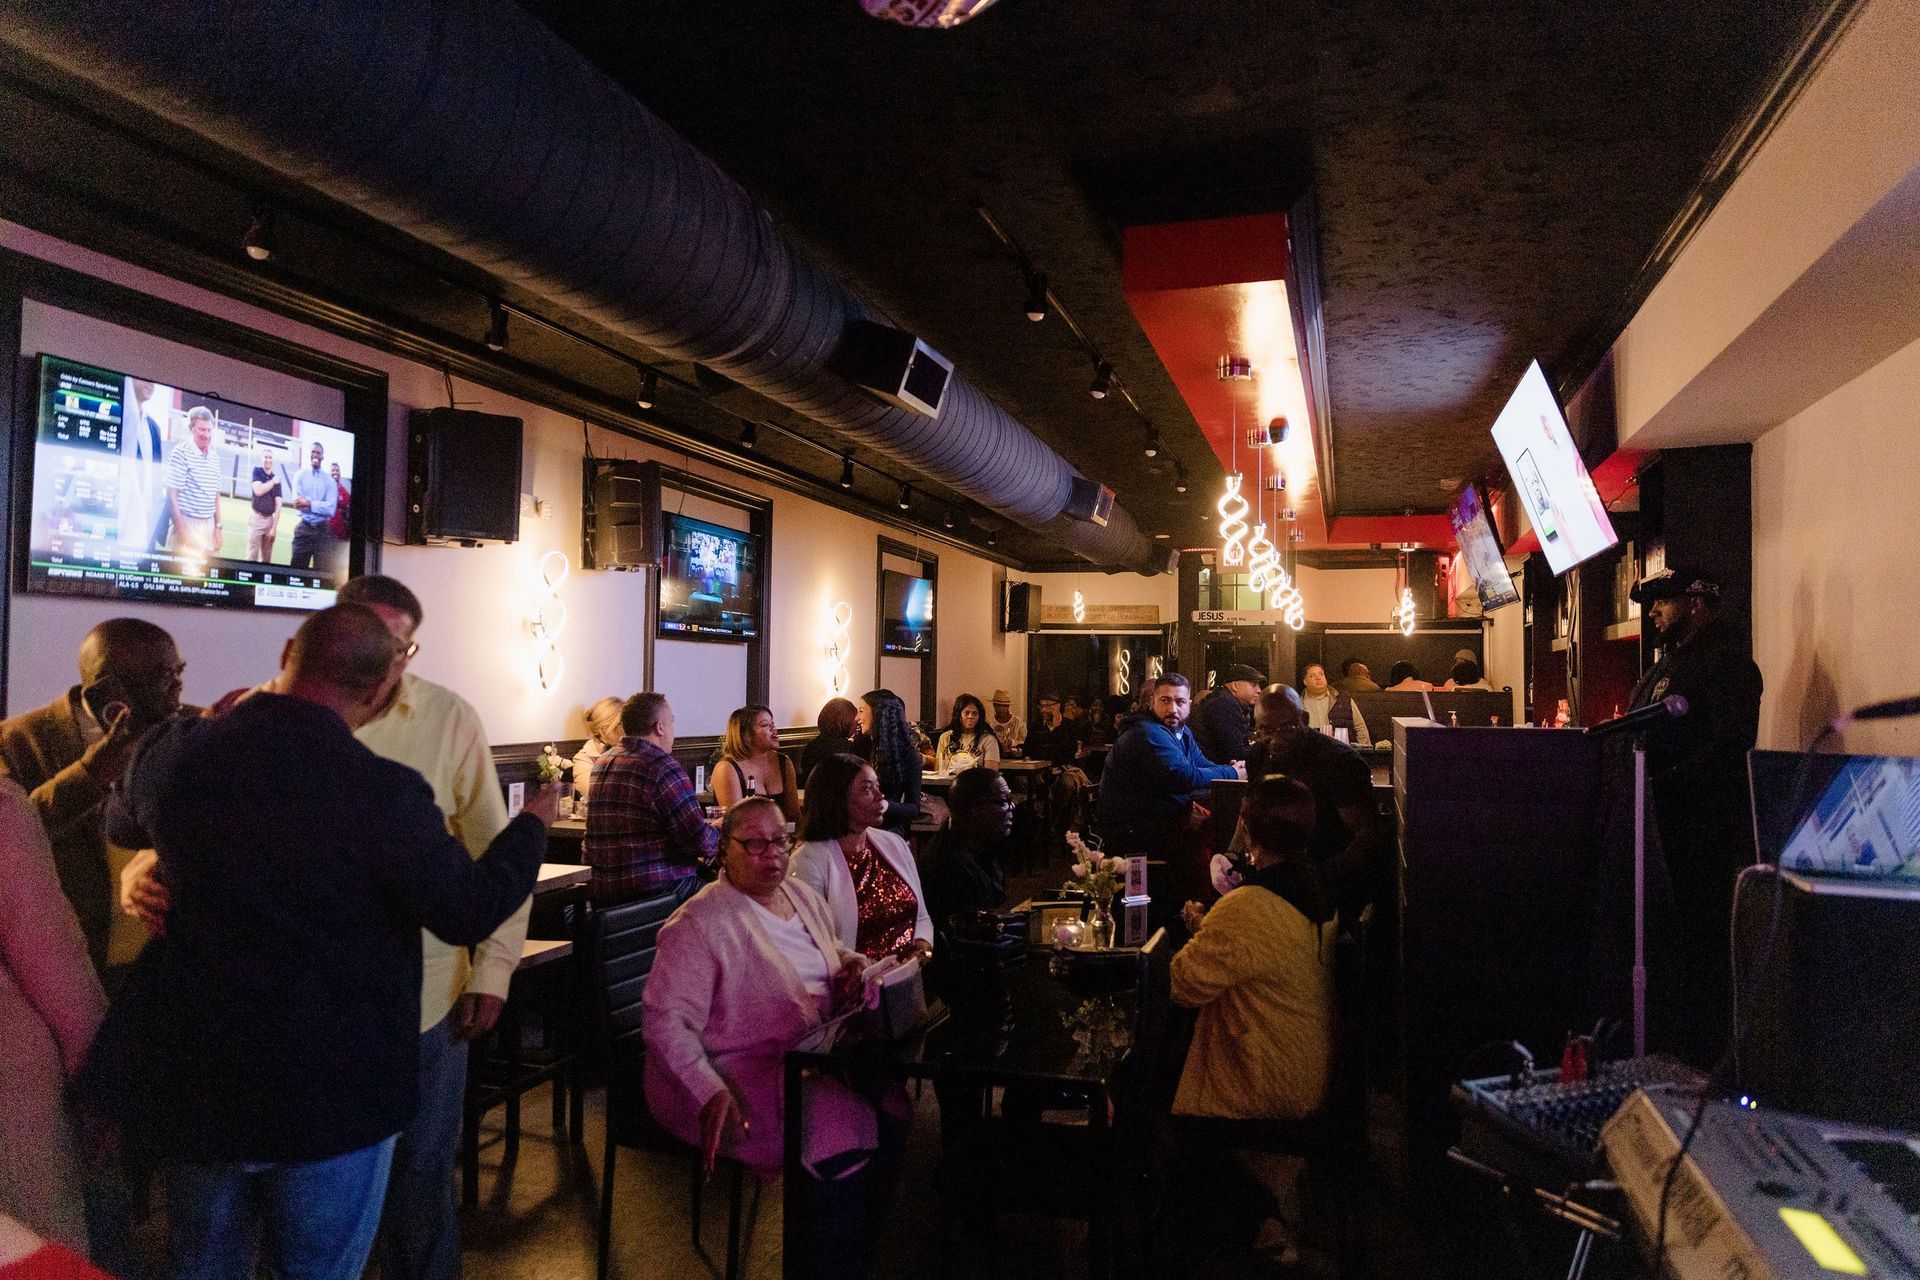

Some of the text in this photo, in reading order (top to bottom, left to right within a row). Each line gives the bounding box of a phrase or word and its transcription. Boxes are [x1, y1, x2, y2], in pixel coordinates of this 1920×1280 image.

[125, 574, 144, 582] UConn
[159, 577, 182, 585] Alabama
[1197, 611, 1224, 621] JESUS
